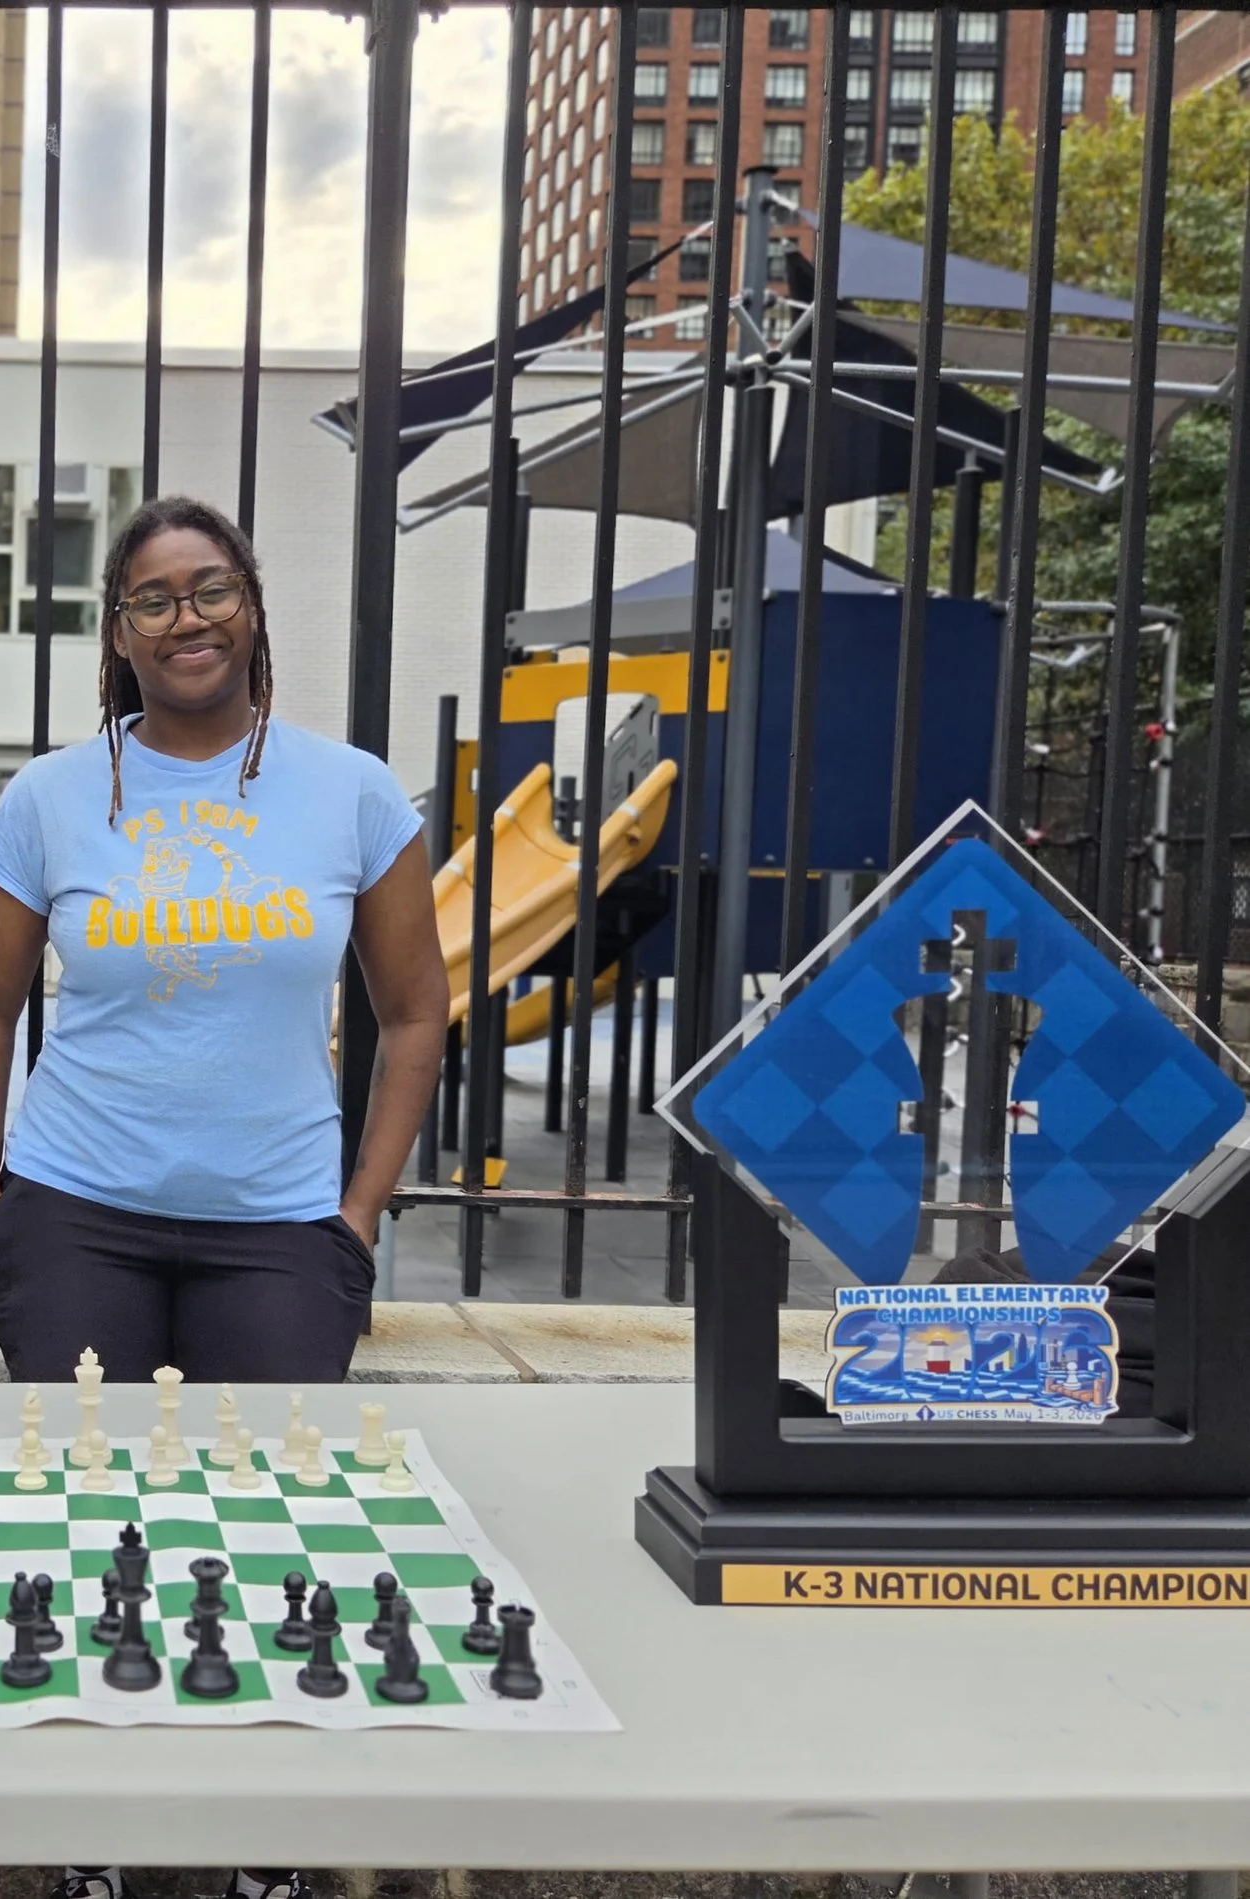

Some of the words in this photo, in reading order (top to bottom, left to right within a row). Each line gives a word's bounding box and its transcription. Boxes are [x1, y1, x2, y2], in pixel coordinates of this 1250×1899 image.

[122, 808, 165, 844] PS
[180, 800, 259, 838] 198M
[839, 1288, 952, 1305] NATIONAL
[957, 1287, 1107, 1304] ELEMENTARY
[877, 1306, 1062, 1324] CHAMPIONSHIPS
[844, 1410, 909, 1423] Baltimore
[937, 1410, 954, 1420] US
[957, 1410, 998, 1419] CHESS
[1004, 1408, 1032, 1421] May
[1037, 1409, 1063, 1421] 1-3,
[1067, 1408, 1102, 1420] 2026
[783, 1571, 843, 1598] K-3
[854, 1572, 1040, 1600] NATIONAL
[1051, 1573, 1247, 1601] CHAMPION
